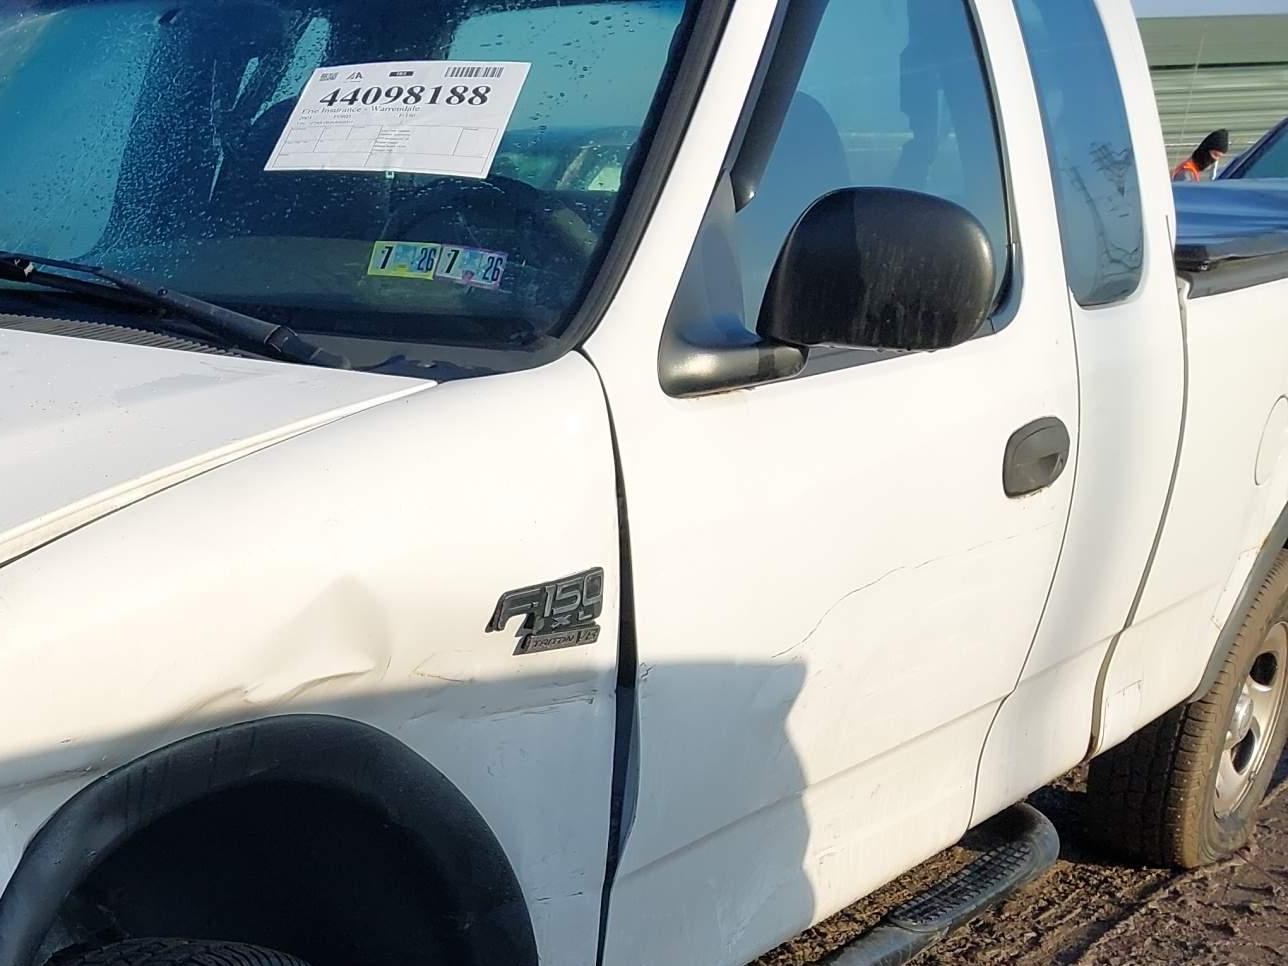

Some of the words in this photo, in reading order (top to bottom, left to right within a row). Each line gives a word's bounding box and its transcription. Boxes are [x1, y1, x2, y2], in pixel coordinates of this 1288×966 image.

[319, 85, 491, 107] 44098188
[380, 246, 393, 270] 7
[417, 247, 437, 272] 26
[445, 249, 460, 274] 7
[482, 256, 504, 282] 26
